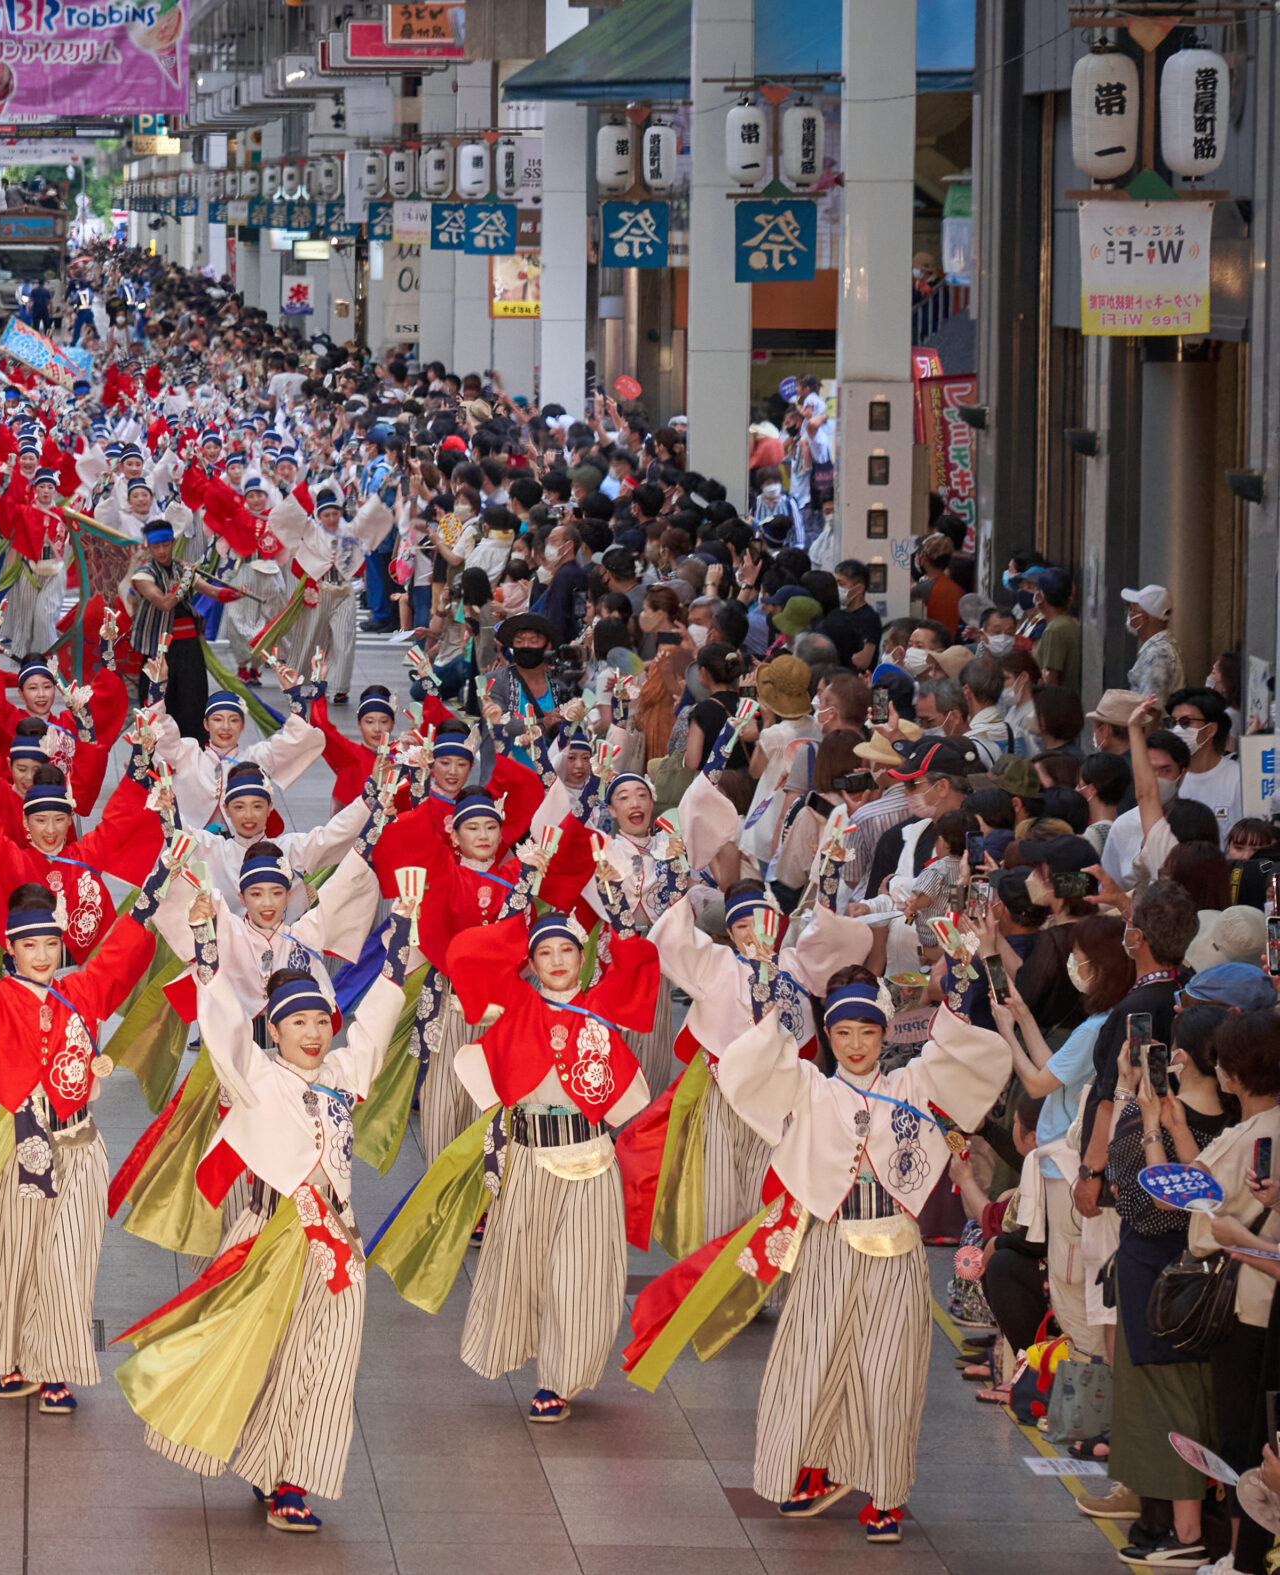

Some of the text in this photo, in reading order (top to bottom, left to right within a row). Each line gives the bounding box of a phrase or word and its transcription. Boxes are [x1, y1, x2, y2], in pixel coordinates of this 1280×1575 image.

[66, 5, 155, 27] robbins
[23, 41, 121, 63] アイスクリーム
[139, 114, 153, 134] P
[1094, 82, 1127, 157] 帯一
[1193, 67, 1218, 160] 帯屋町筋
[616, 139, 629, 176] 帯一
[649, 134, 662, 180] 帯屋町筋
[741, 123, 761, 170] 帯一
[801, 117, 816, 174] 帯屋町筋
